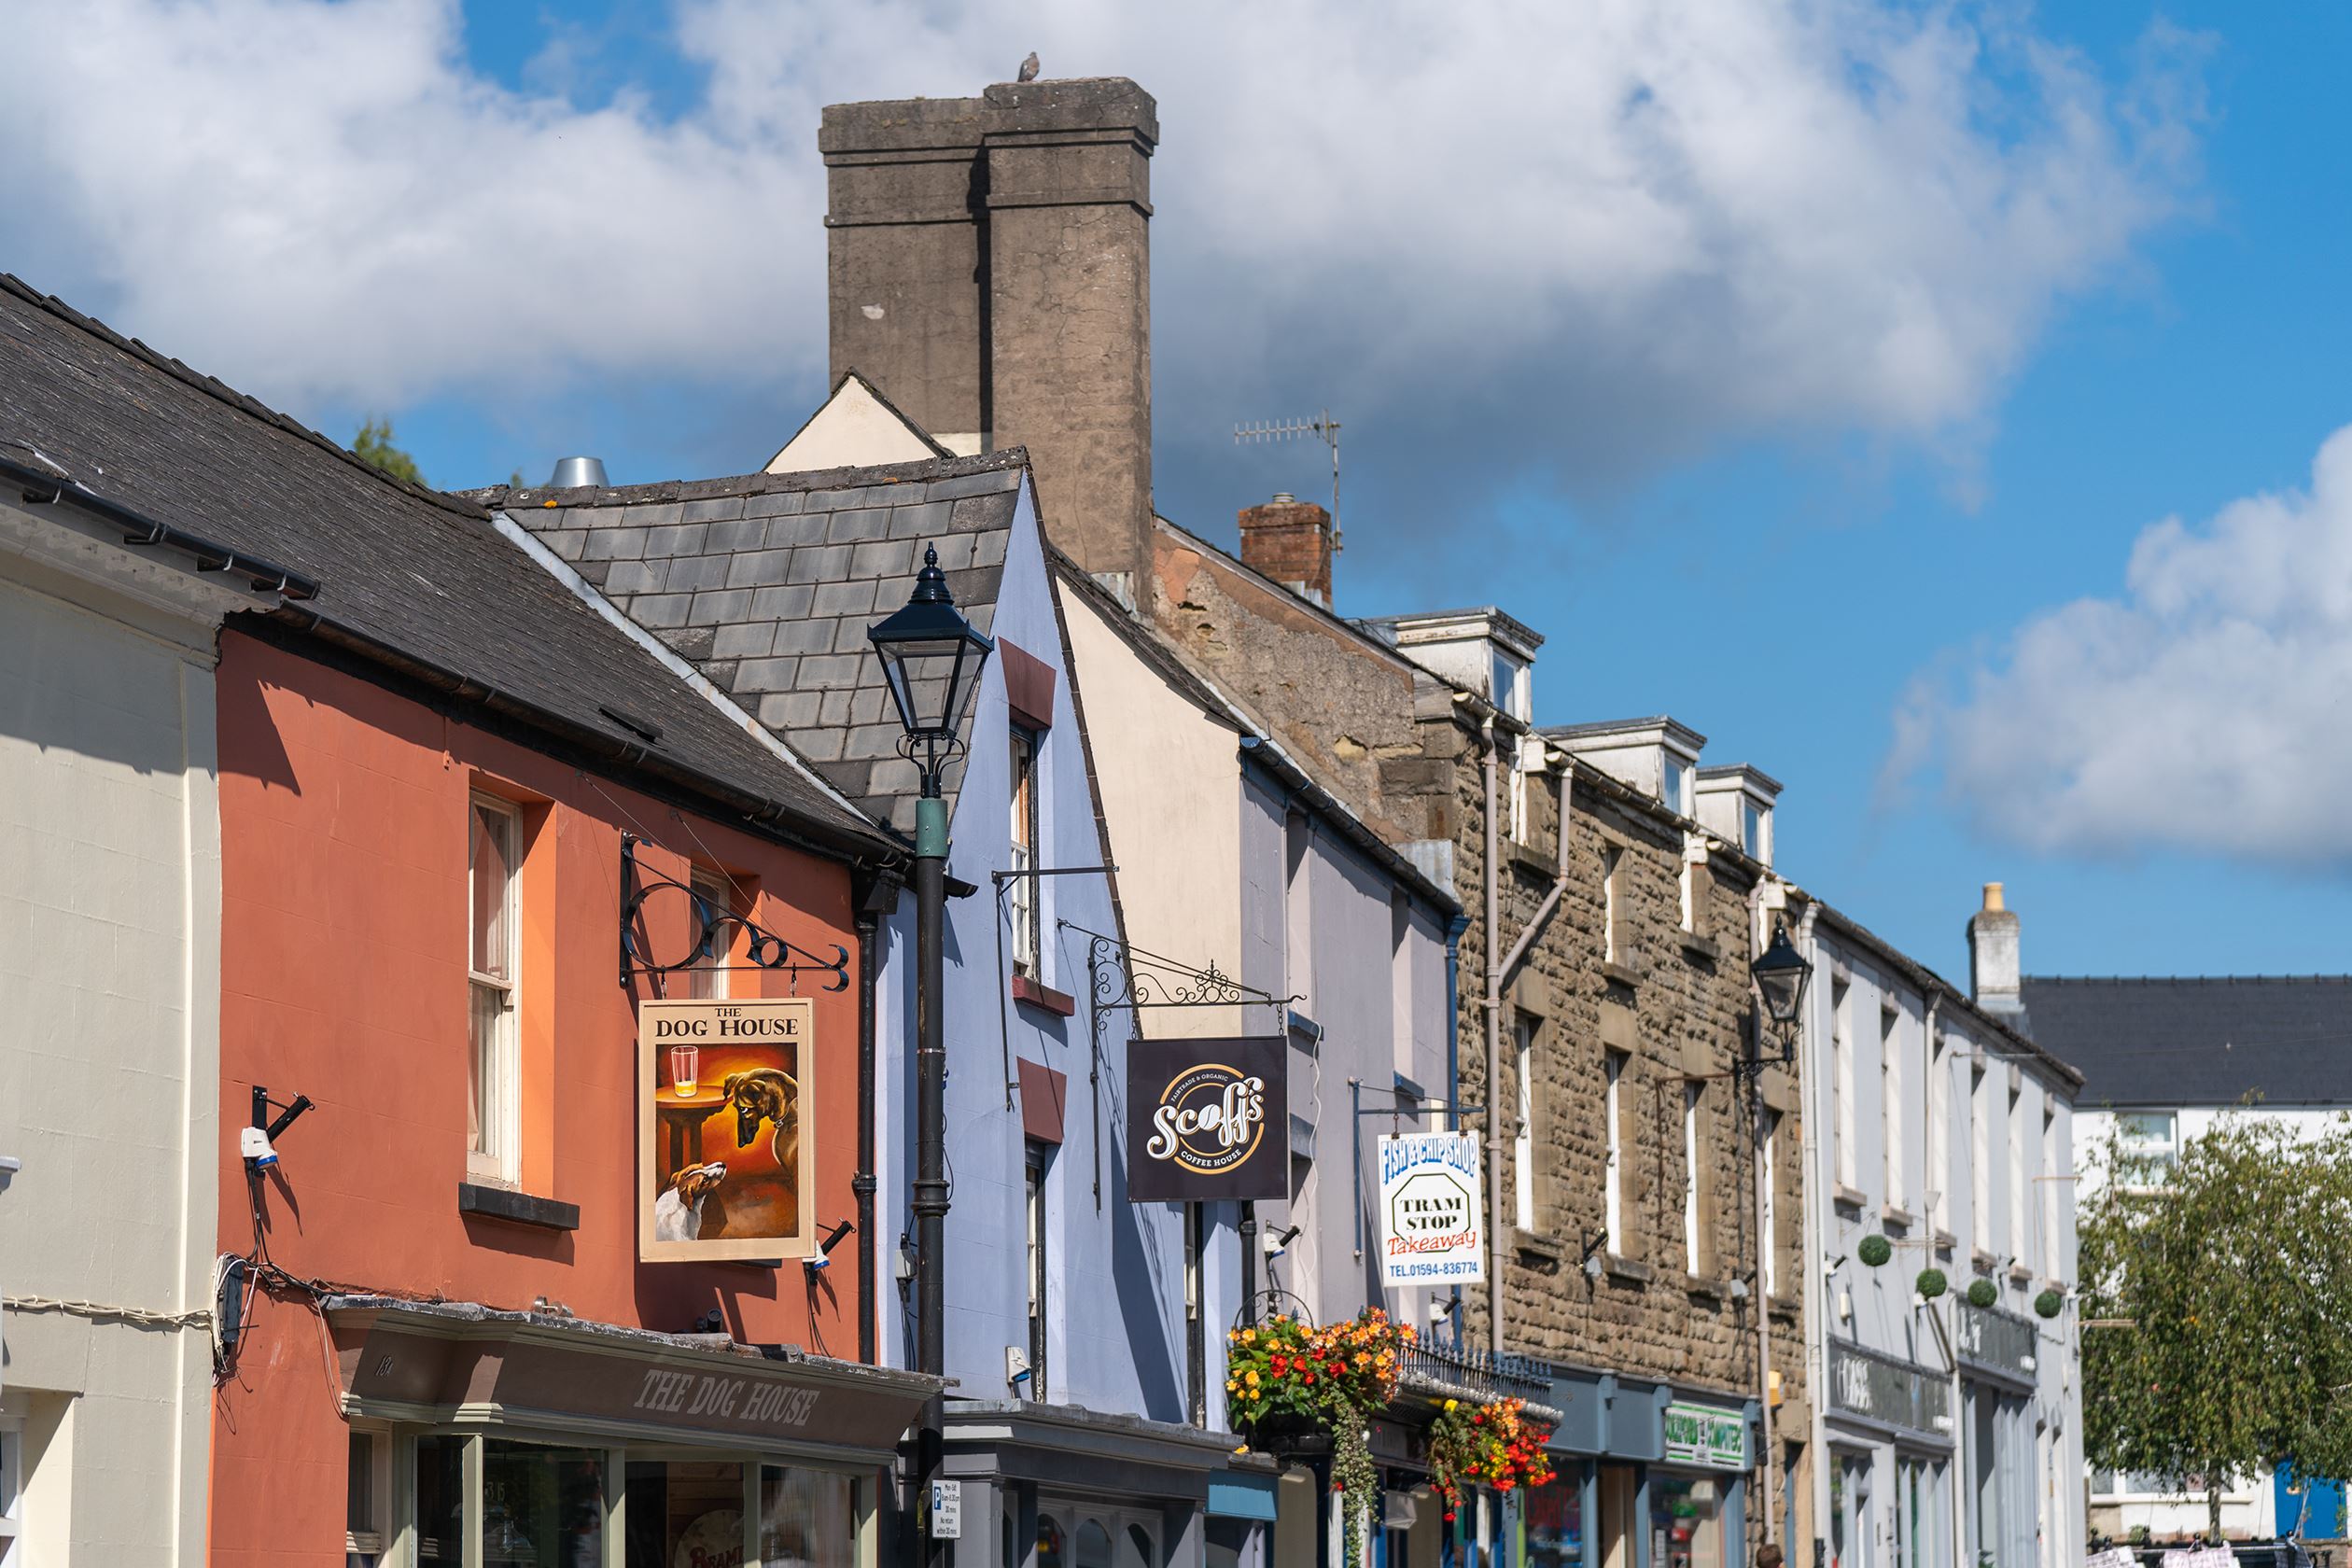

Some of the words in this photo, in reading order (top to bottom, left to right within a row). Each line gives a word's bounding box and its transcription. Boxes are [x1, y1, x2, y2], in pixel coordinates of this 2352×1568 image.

[715, 1007, 742, 1017] THE
[655, 1019, 707, 1038] DOG
[720, 1018, 799, 1036] HOUSE
[1170, 1077, 1197, 1102] FAIRTRADE
[1201, 1073, 1229, 1082] ORGANIC
[1146, 1076, 1266, 1160] Scoff's
[1181, 1150, 1212, 1167] COFFEE
[1214, 1149, 1242, 1167] HOUSE
[1381, 1140, 1408, 1185] FISH
[1408, 1139, 1419, 1166] &
[1419, 1138, 1445, 1163] CHIP
[1446, 1136, 1477, 1178] SHOP
[1400, 1197, 1463, 1213] TRAM
[1407, 1215, 1458, 1230] STOP
[1387, 1231, 1477, 1256] Takeaway
[634, 1369, 695, 1412] THE
[687, 1376, 747, 1418] DOG
[739, 1382, 820, 1427] HOUSE
[935, 1488, 941, 1509] P
